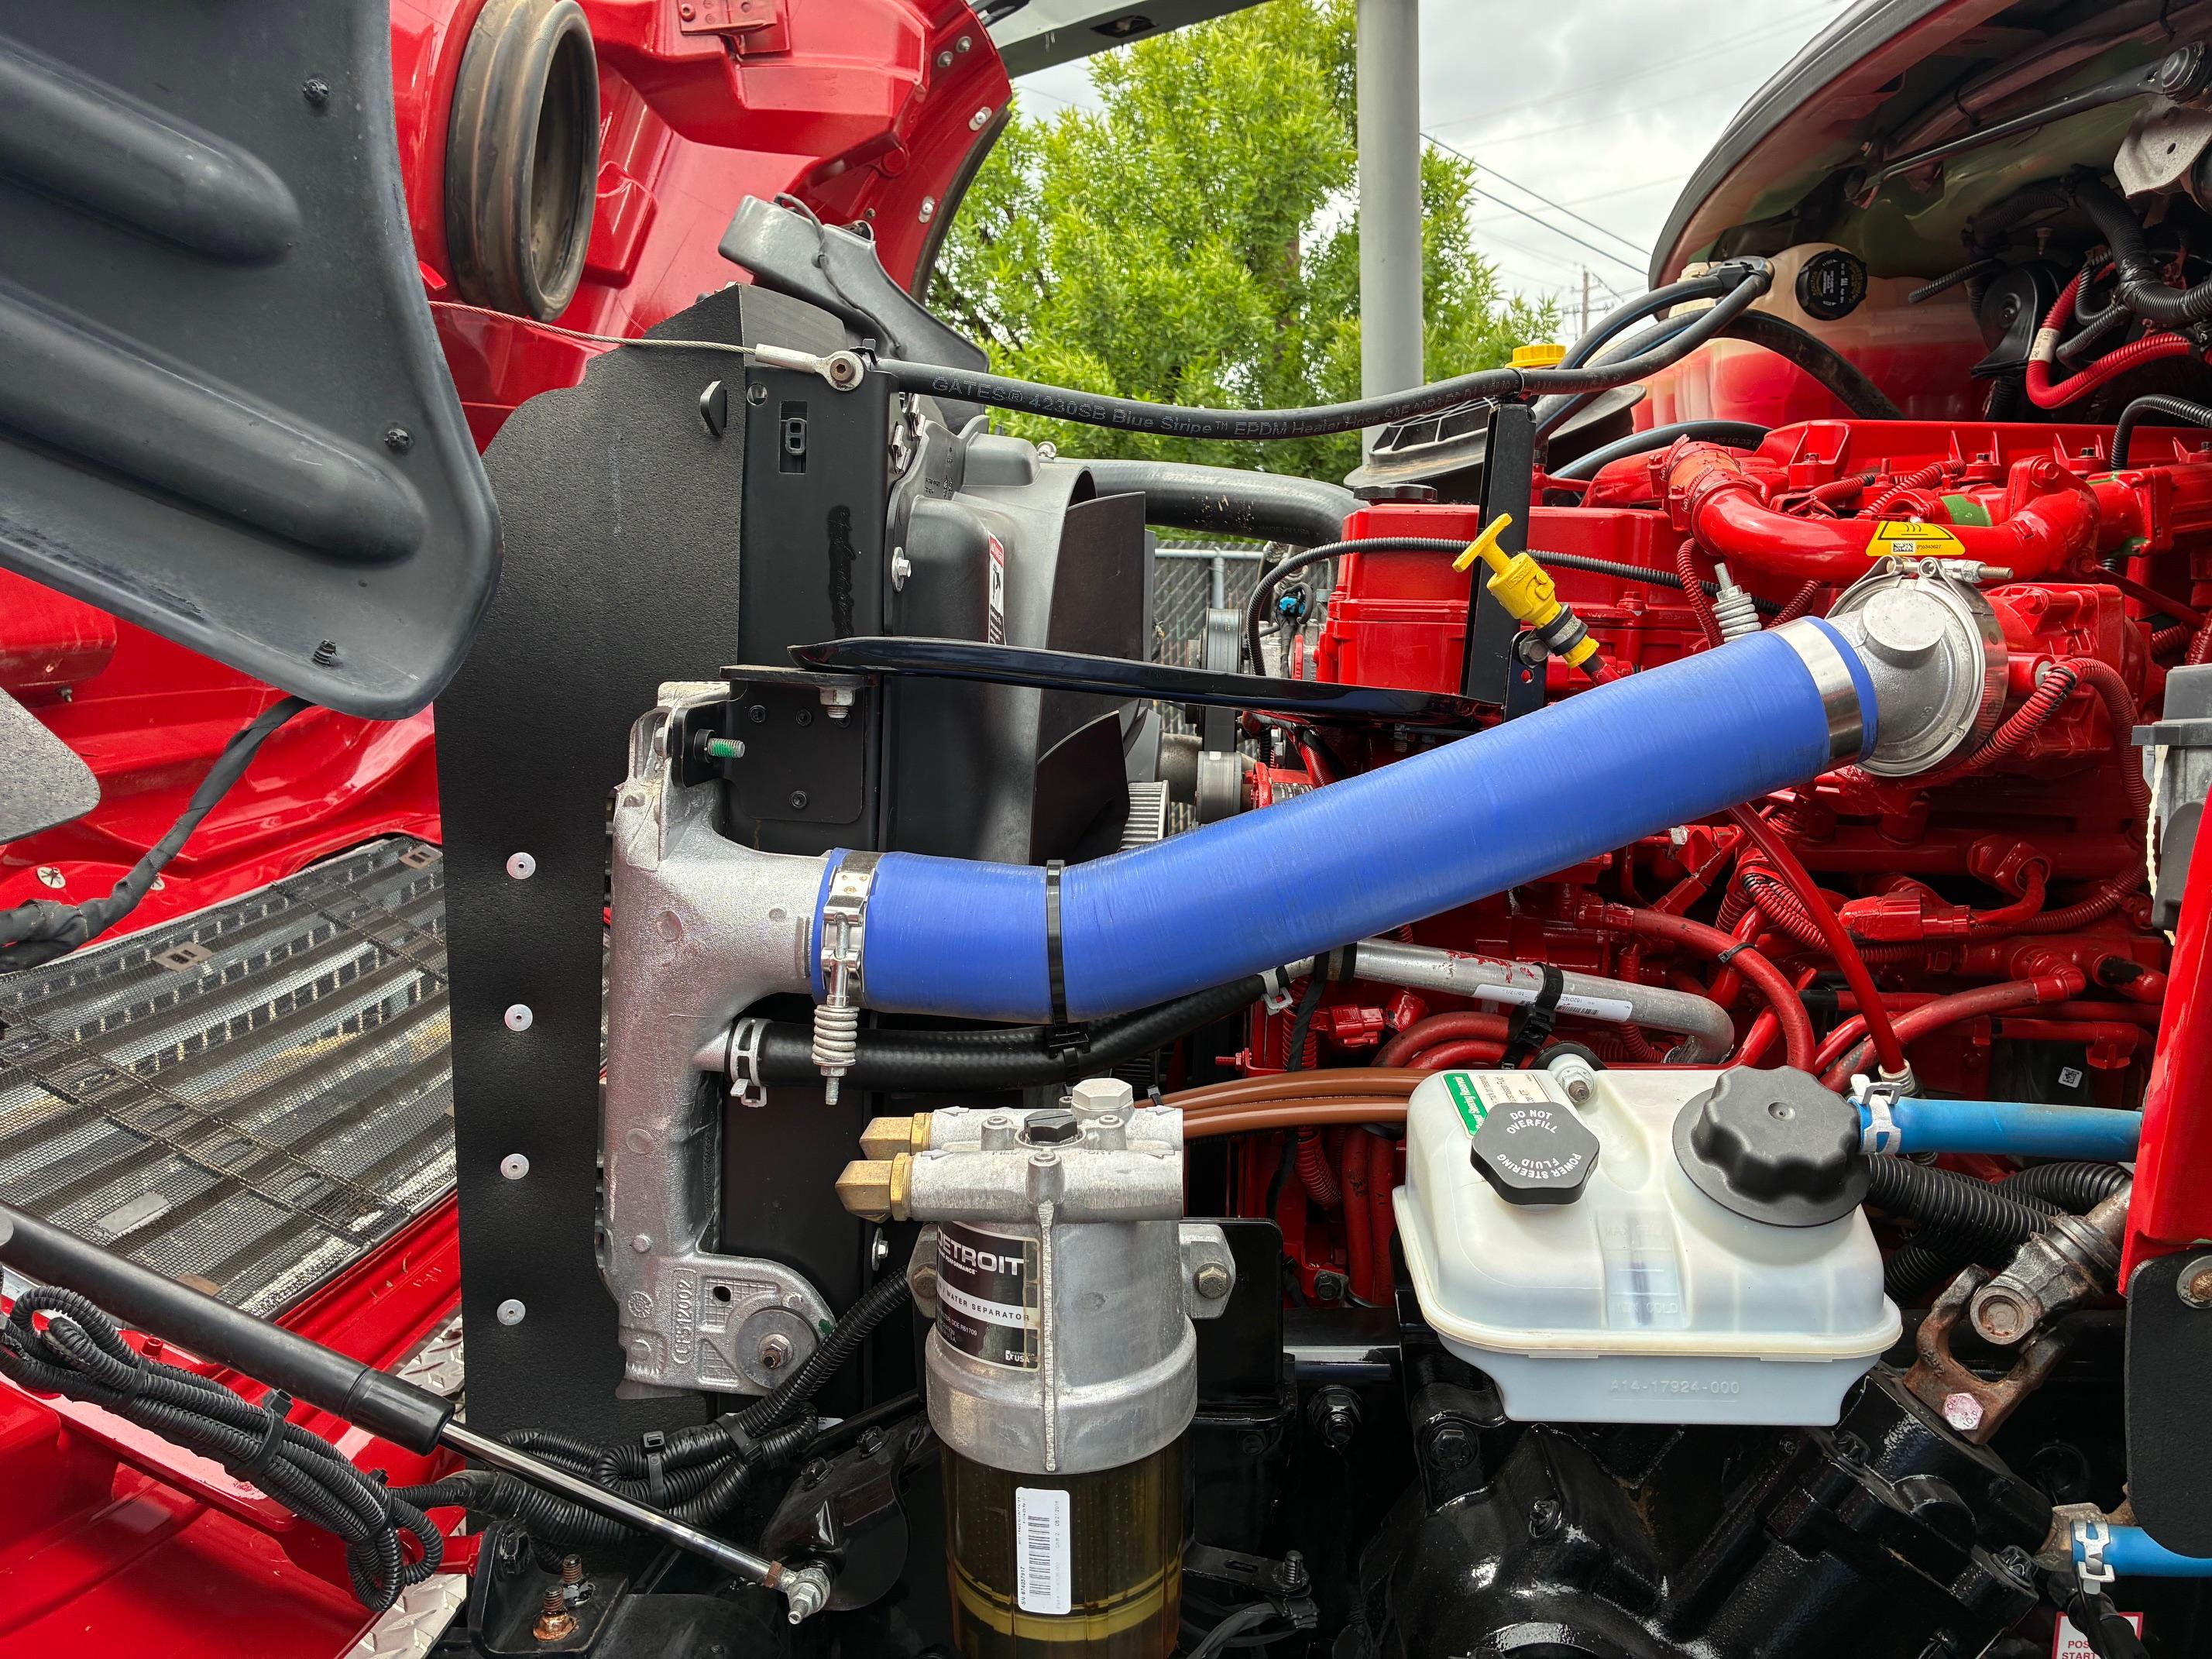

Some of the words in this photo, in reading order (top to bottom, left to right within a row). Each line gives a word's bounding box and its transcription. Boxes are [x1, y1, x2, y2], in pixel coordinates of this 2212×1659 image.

[933, 376, 1022, 403] GATES®
[1029, 393, 1106, 420] 4230SB
[1113, 408, 1154, 428] Blue
[1160, 416, 1228, 434] Stripe™
[1234, 422, 1287, 436] EPDM
[1292, 420, 1340, 435] Heater
[1343, 414, 1380, 429] Hose
[1453, 1077, 1471, 1096] Reservoir
[1464, 1096, 1480, 1115] Steering
[1510, 1110, 1526, 1121] DO
[1530, 1109, 1552, 1120] NOT
[1506, 1118, 1558, 1134] OVERFILL
[1496, 1153, 1549, 1179] STEERING
[1521, 1157, 1560, 1170] FLUID
[1551, 1152, 1582, 1177] POWER
[938, 1225, 1025, 1276] DETROIT
[946, 1290, 967, 1307] WATER
[971, 1304, 1029, 1321] SEPARATOR
[1646, 1303, 1678, 1314] COLD
[1015, 1355, 1030, 1363] USA
[1021, 1595, 1026, 1606] SN
